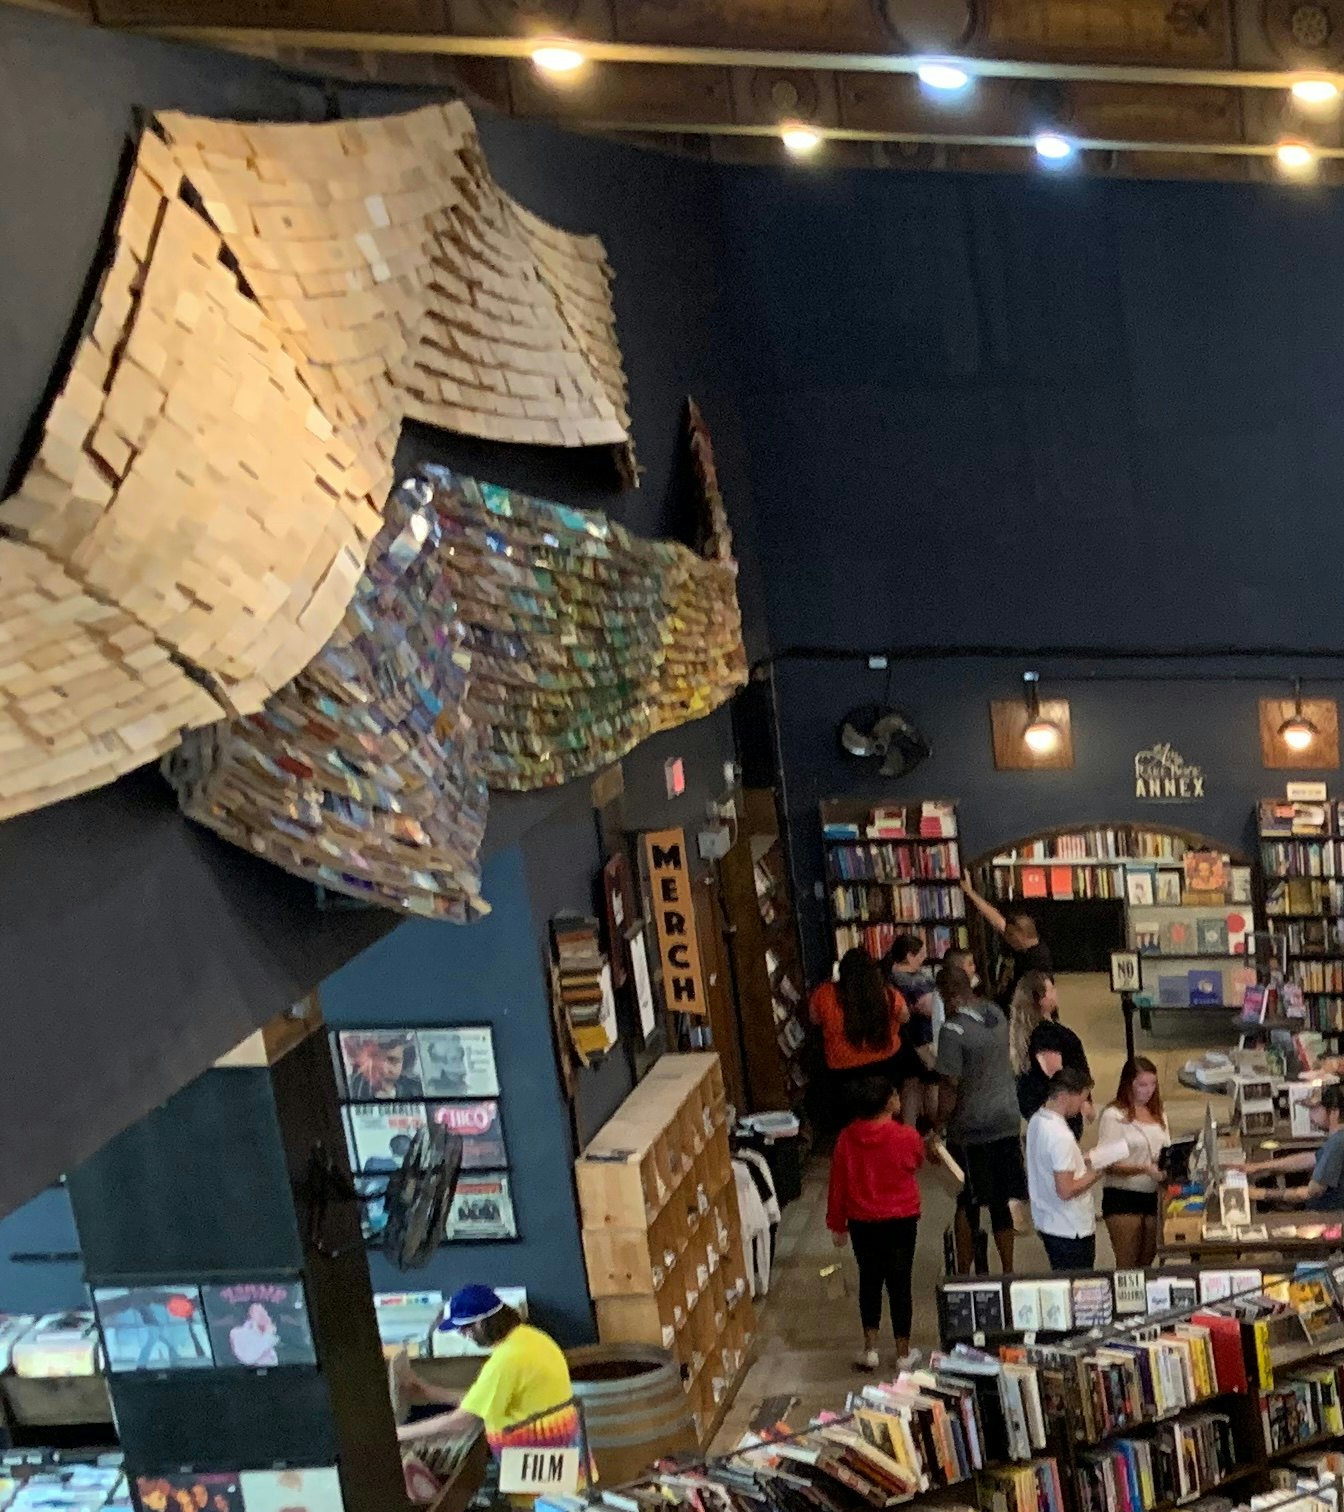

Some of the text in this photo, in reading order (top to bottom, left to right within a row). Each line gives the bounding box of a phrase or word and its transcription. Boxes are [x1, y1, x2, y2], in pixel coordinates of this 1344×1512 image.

[1136, 777, 1204, 797] ANNEX
[652, 843, 696, 1002] MERCH
[1117, 1273, 1140, 1288] BEST
[521, 1453, 564, 1482] FILM
